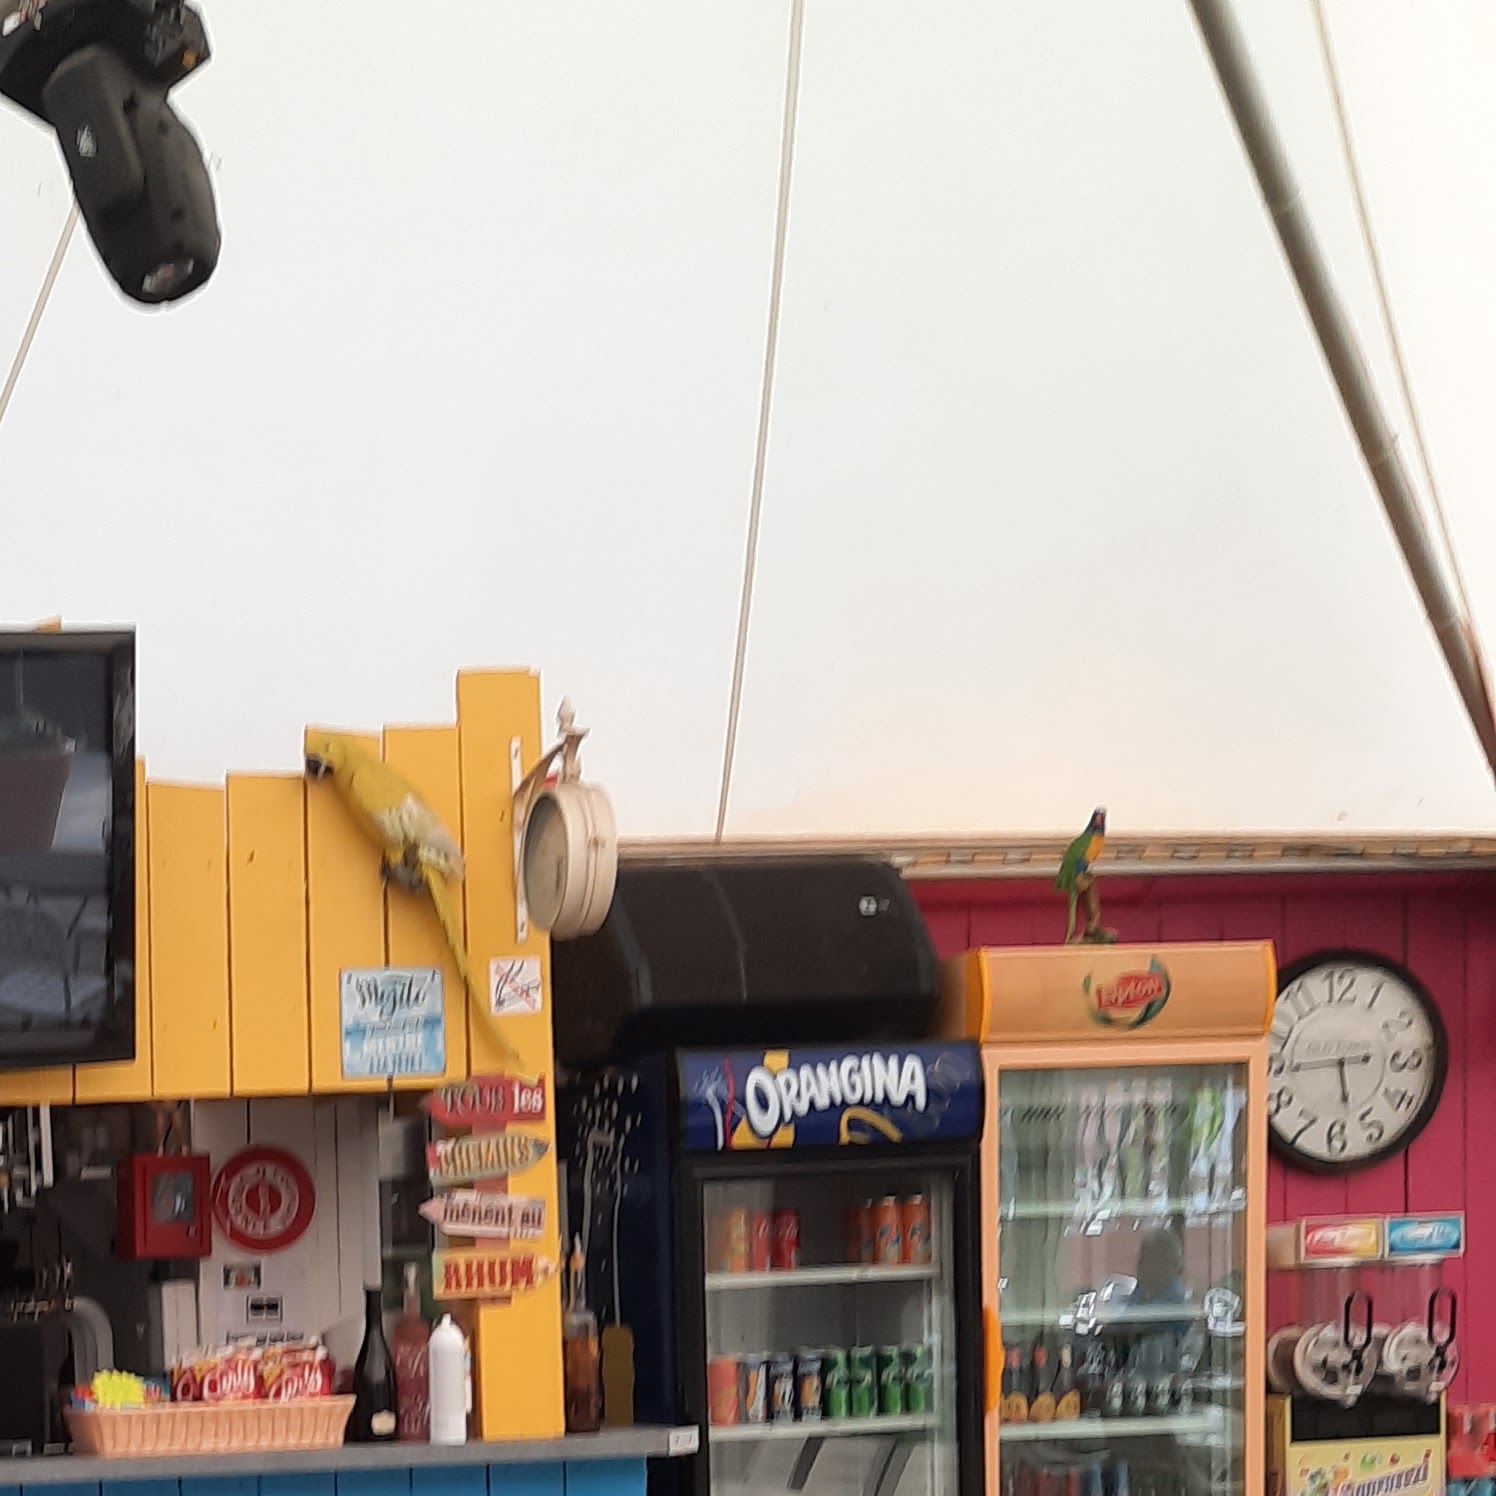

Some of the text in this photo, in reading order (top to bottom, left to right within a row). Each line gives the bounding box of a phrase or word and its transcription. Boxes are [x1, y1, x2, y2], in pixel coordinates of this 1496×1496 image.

[1324, 969, 1357, 1003] 12
[1366, 978, 1386, 1011] 1
[1389, 1047, 1423, 1074] 3
[744, 1050, 927, 1139] ORANGINA
[1382, 1086, 1416, 1113] 4
[1290, 1107, 1319, 1147] 7
[1326, 1118, 1348, 1154] 6
[1358, 1106, 1385, 1144] 5
[444, 1255, 535, 1291] RHUM
